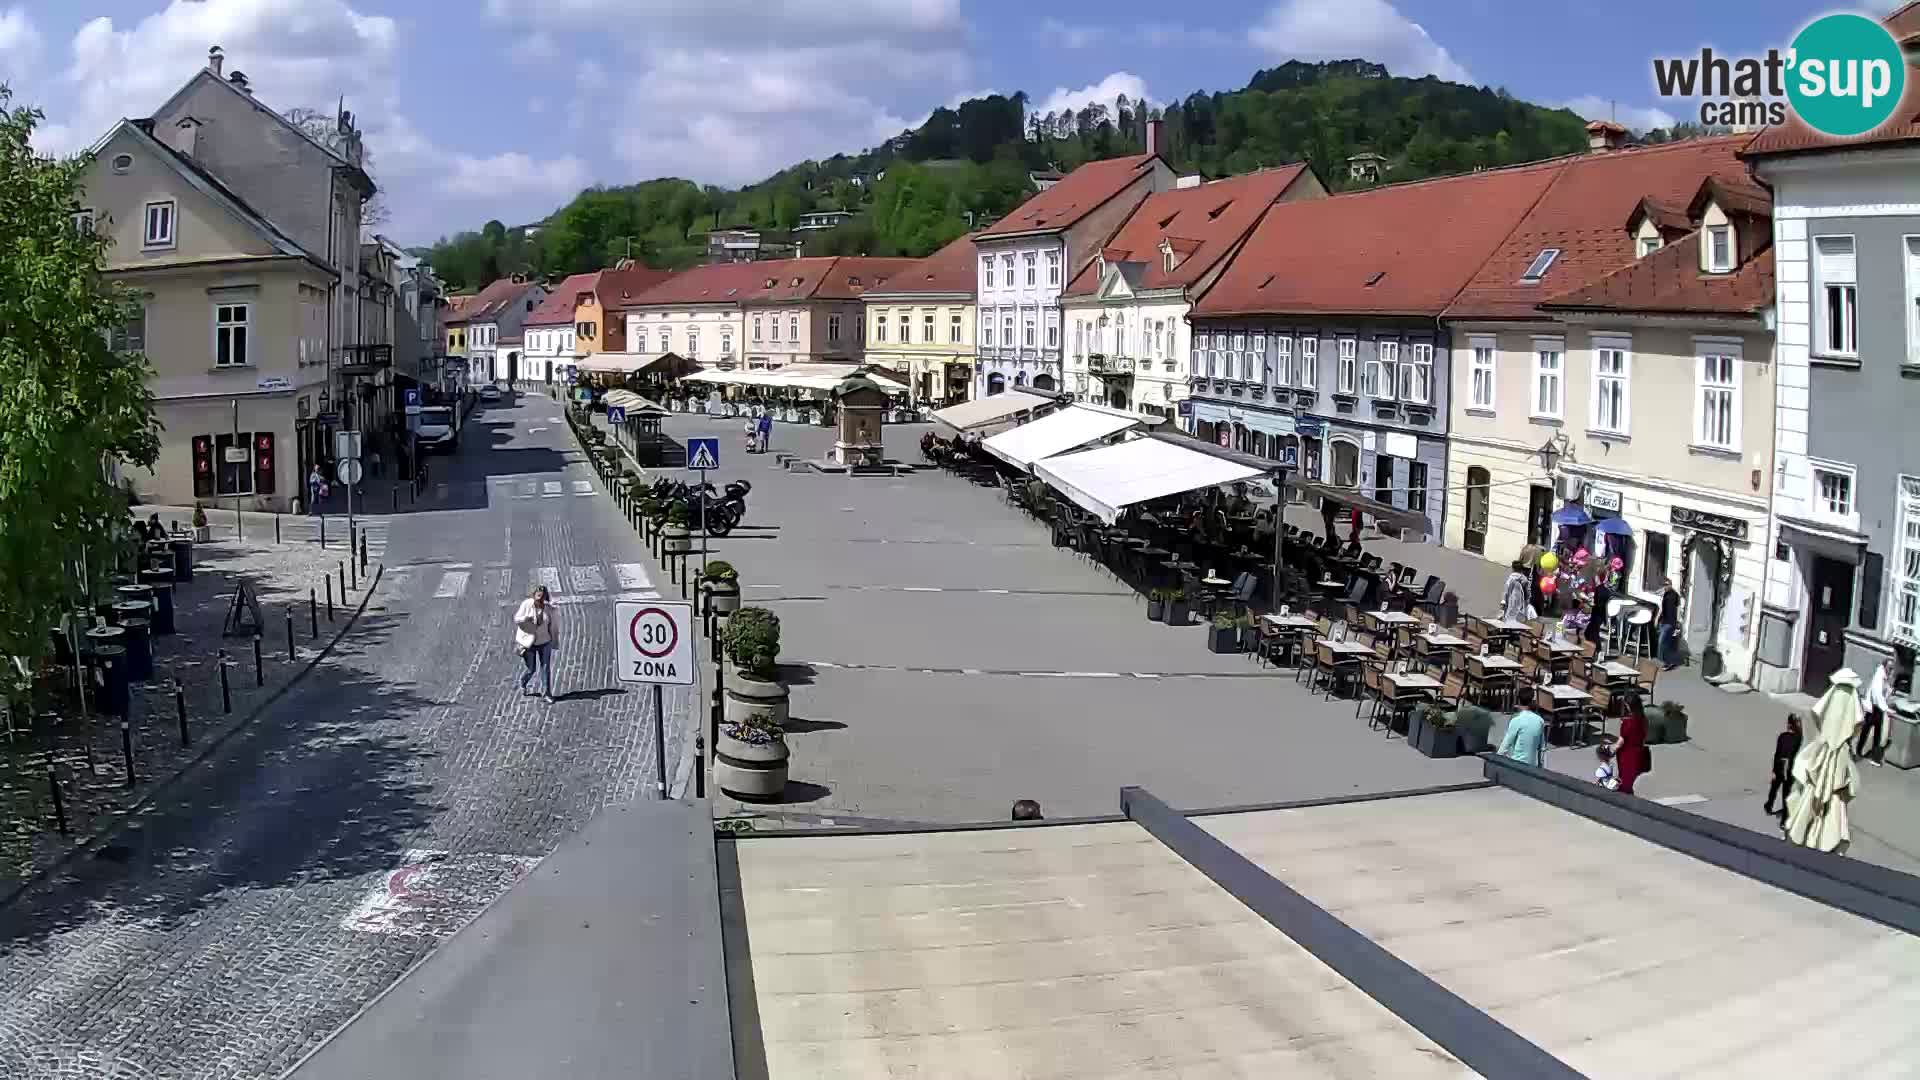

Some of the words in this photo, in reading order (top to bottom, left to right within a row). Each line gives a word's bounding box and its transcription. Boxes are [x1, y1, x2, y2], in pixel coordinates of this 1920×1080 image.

[408, 392, 417, 403] P
[642, 623, 667, 645] 30
[632, 661, 677, 677] ZONA
